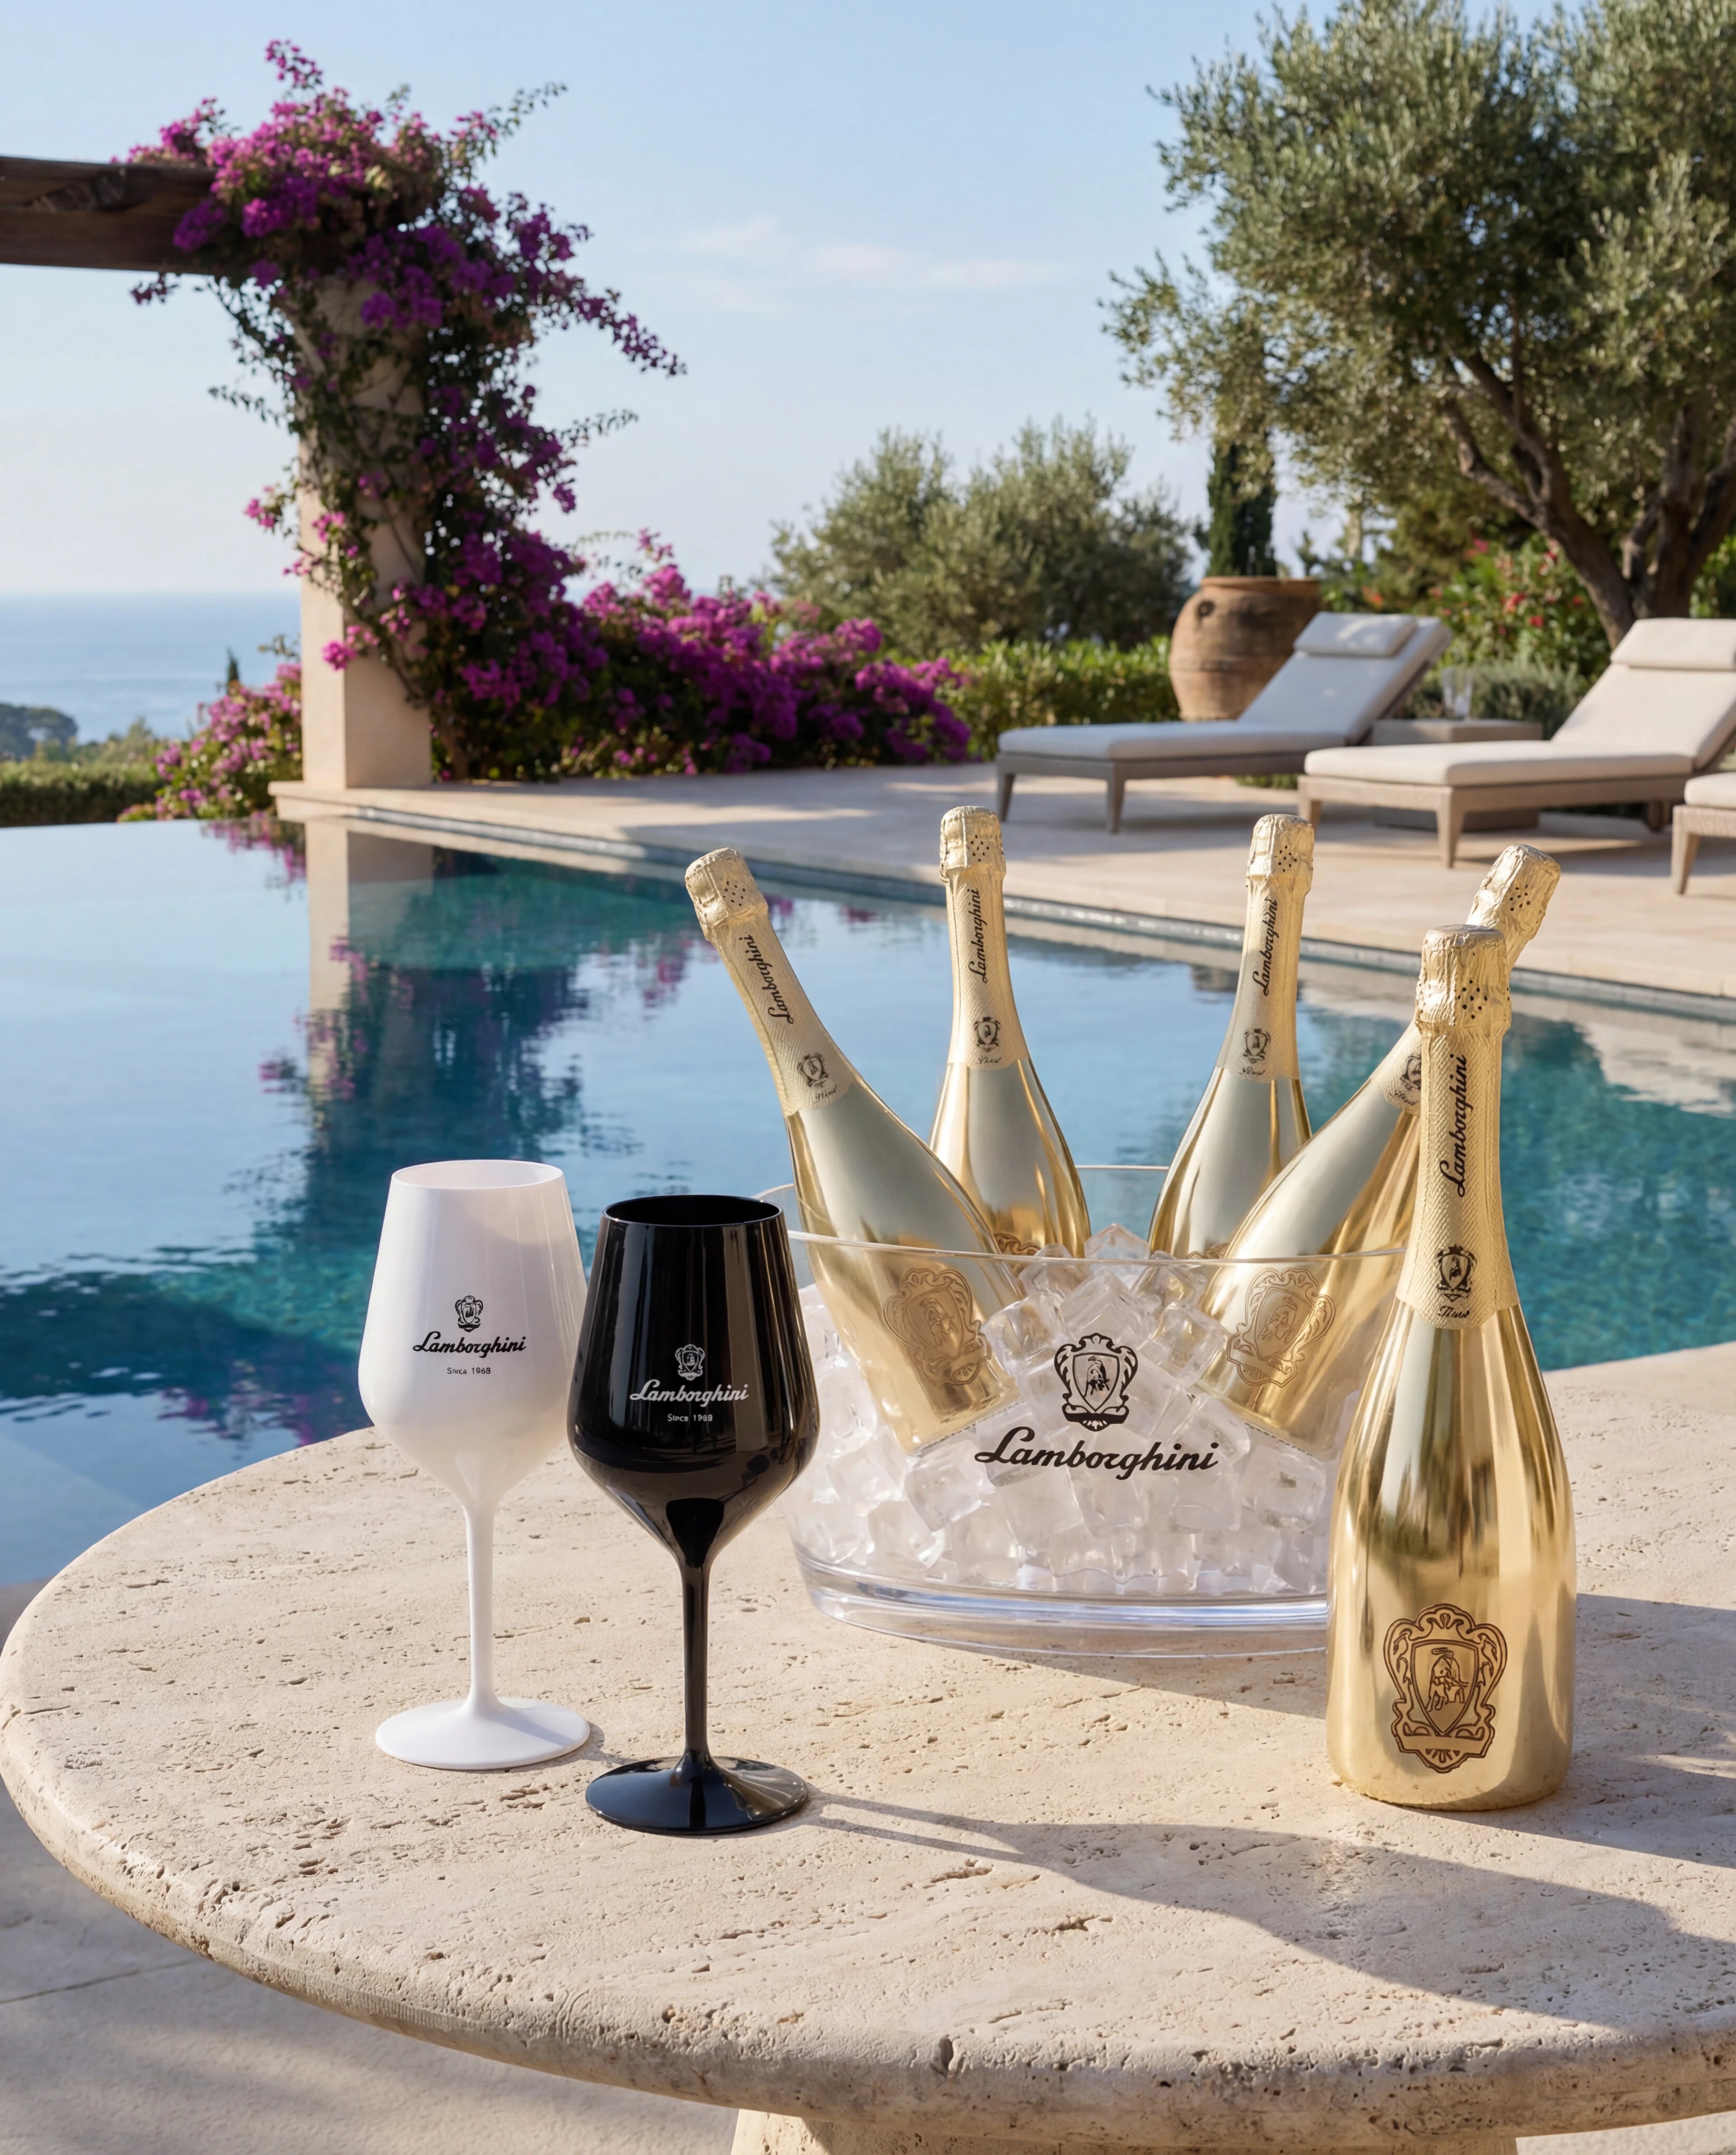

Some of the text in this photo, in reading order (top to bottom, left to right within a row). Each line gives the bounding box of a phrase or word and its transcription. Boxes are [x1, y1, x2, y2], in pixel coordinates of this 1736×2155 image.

[738, 934, 794, 1025] Lamborghini
[967, 887, 988, 983] Lamborghini
[1252, 897, 1280, 997] Lamborghini
[1439, 1053, 1474, 1197] Lamborghini
[412, 1331, 527, 1358] Lamborghini
[629, 1379, 749, 1407] Lamborghini
[974, 1426, 1219, 1480] Lamborghini
